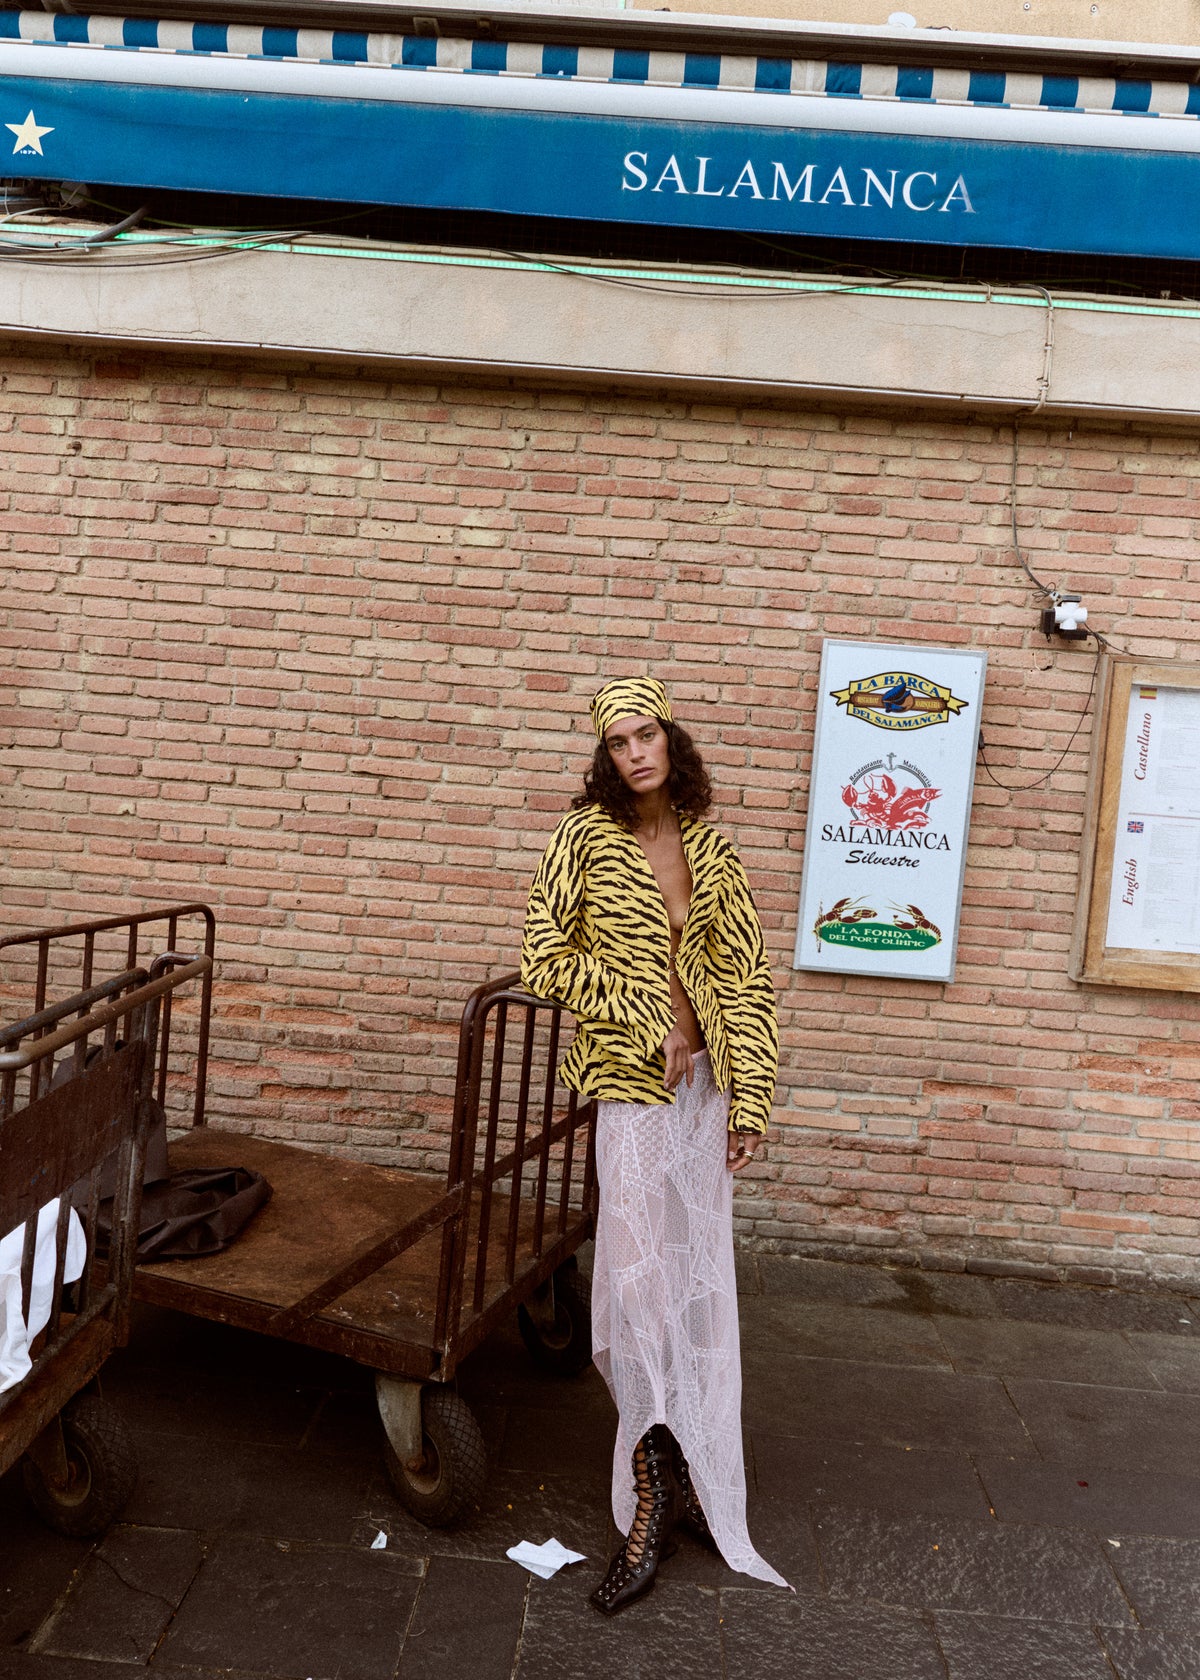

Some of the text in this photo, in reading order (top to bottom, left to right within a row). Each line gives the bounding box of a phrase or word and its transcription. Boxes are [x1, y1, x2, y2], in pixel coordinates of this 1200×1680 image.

[622, 151, 977, 214] SALAMANCA
[857, 675, 940, 698] LA BARCA
[852, 707, 943, 728] DEL SALAMANCA
[1134, 712, 1152, 781] Castellano
[821, 824, 951, 851] SALAMANCA
[845, 849, 920, 868] Silvestre
[1122, 858, 1139, 906] English
[841, 927, 912, 939] LA FONDA
